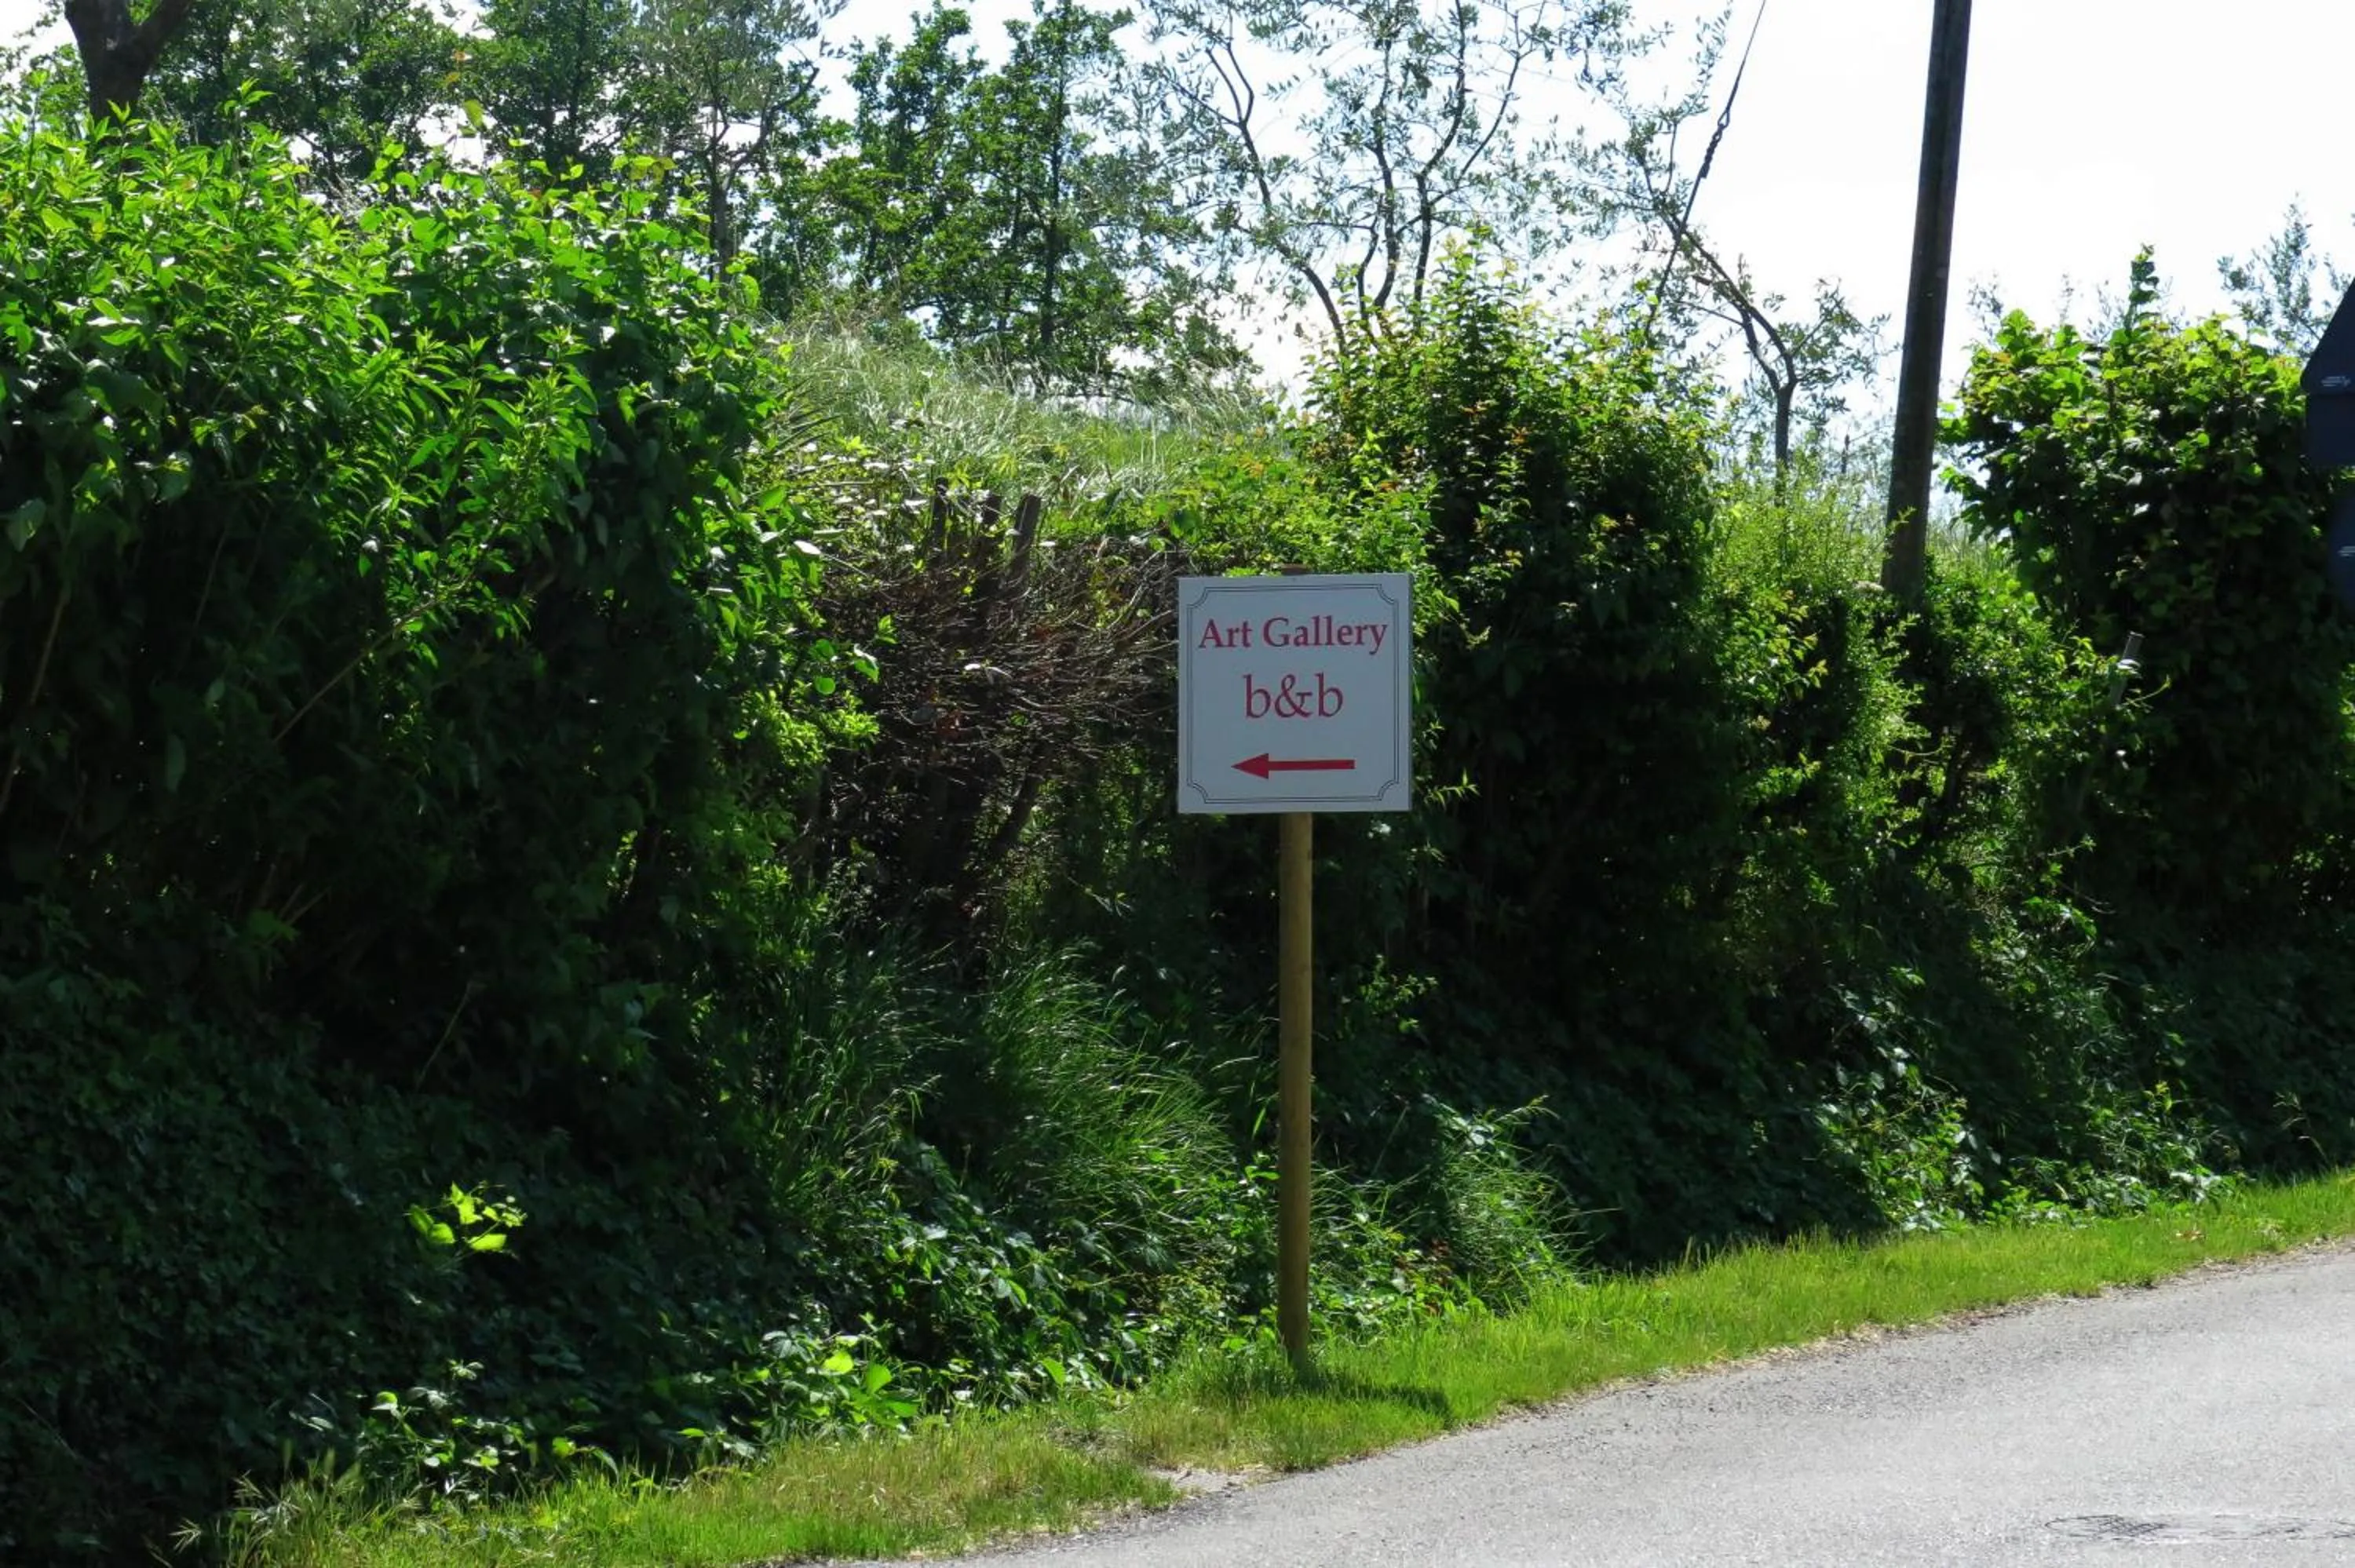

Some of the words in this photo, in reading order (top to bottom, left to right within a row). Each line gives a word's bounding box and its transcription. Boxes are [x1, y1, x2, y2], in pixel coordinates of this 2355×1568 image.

[1198, 618, 1253, 649] Art
[1262, 614, 1388, 655] Gallery
[1243, 672, 1344, 719] b&b
